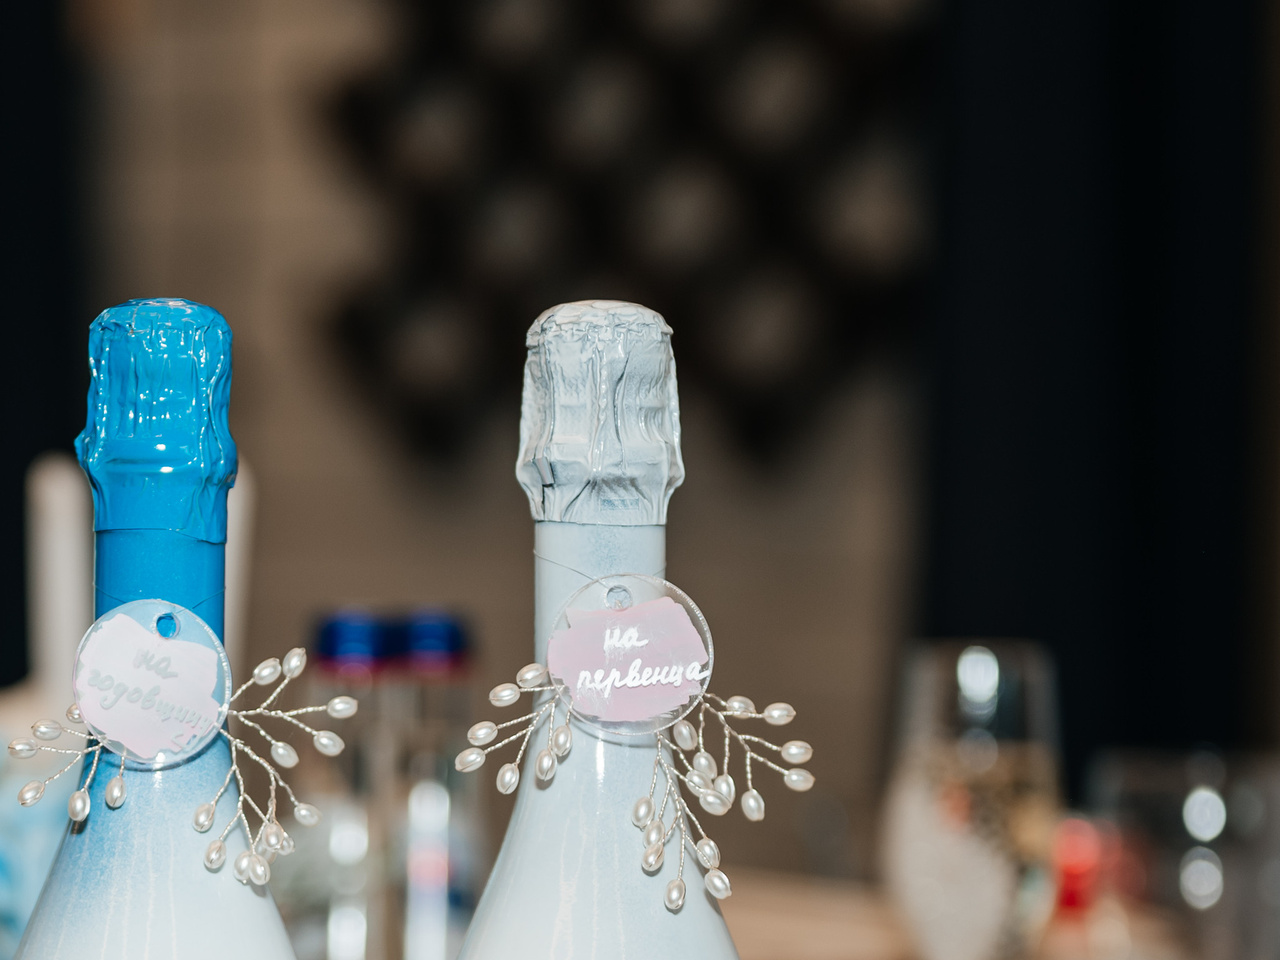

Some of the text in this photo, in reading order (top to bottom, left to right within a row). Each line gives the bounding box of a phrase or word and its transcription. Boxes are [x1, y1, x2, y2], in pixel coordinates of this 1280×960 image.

[603, 624, 649, 648] на
[133, 649, 178, 679] на
[577, 658, 711, 698] первенца
[87, 669, 213, 752] годовщину
